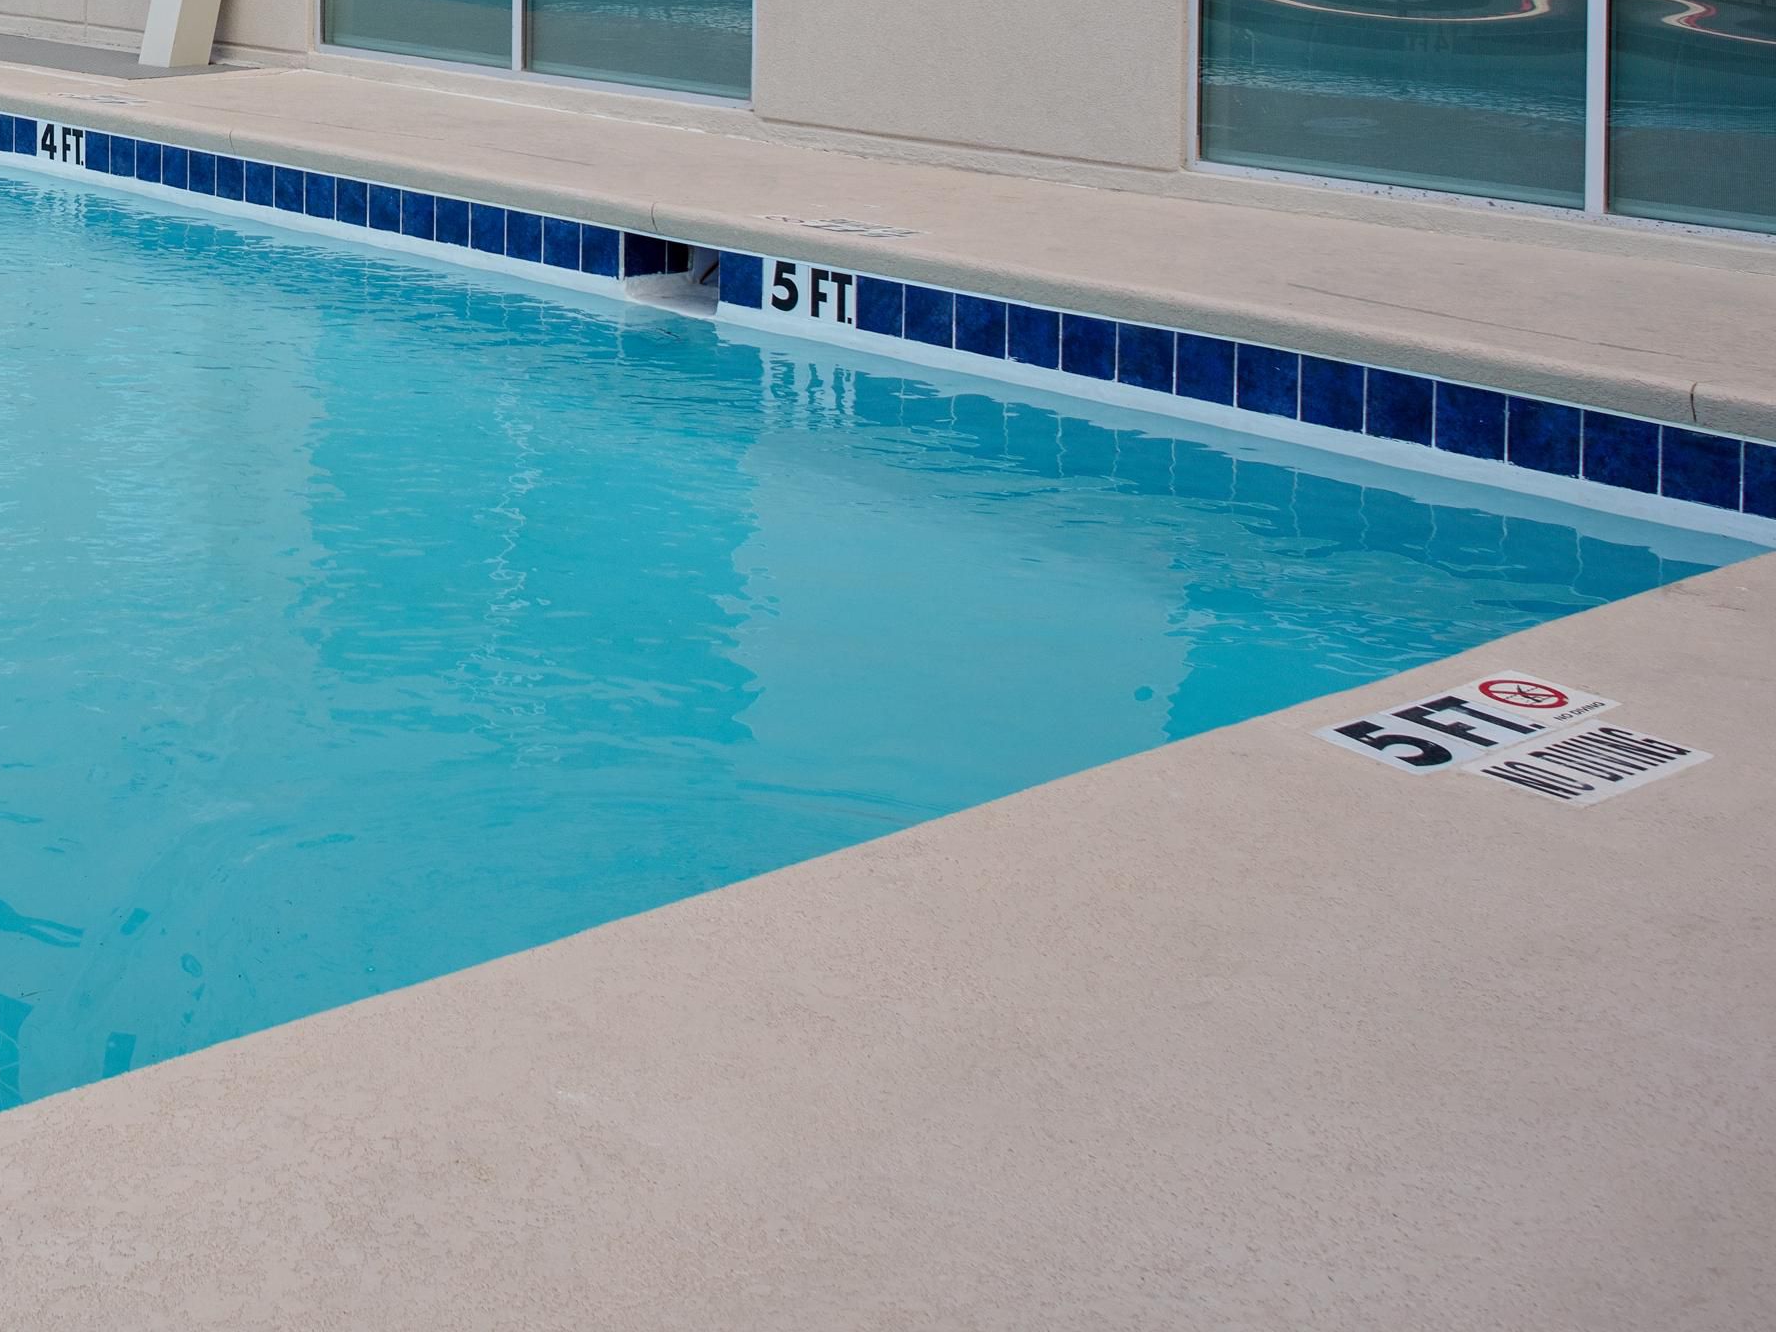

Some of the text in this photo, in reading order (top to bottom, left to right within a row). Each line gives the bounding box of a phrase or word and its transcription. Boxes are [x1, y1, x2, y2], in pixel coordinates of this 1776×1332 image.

[41, 123, 57, 161] 4
[771, 260, 799, 311] 5
[1553, 701, 1606, 723] NO DIVING
[1333, 720, 1453, 767] 5
[1480, 726, 1692, 800] NO DIVING
